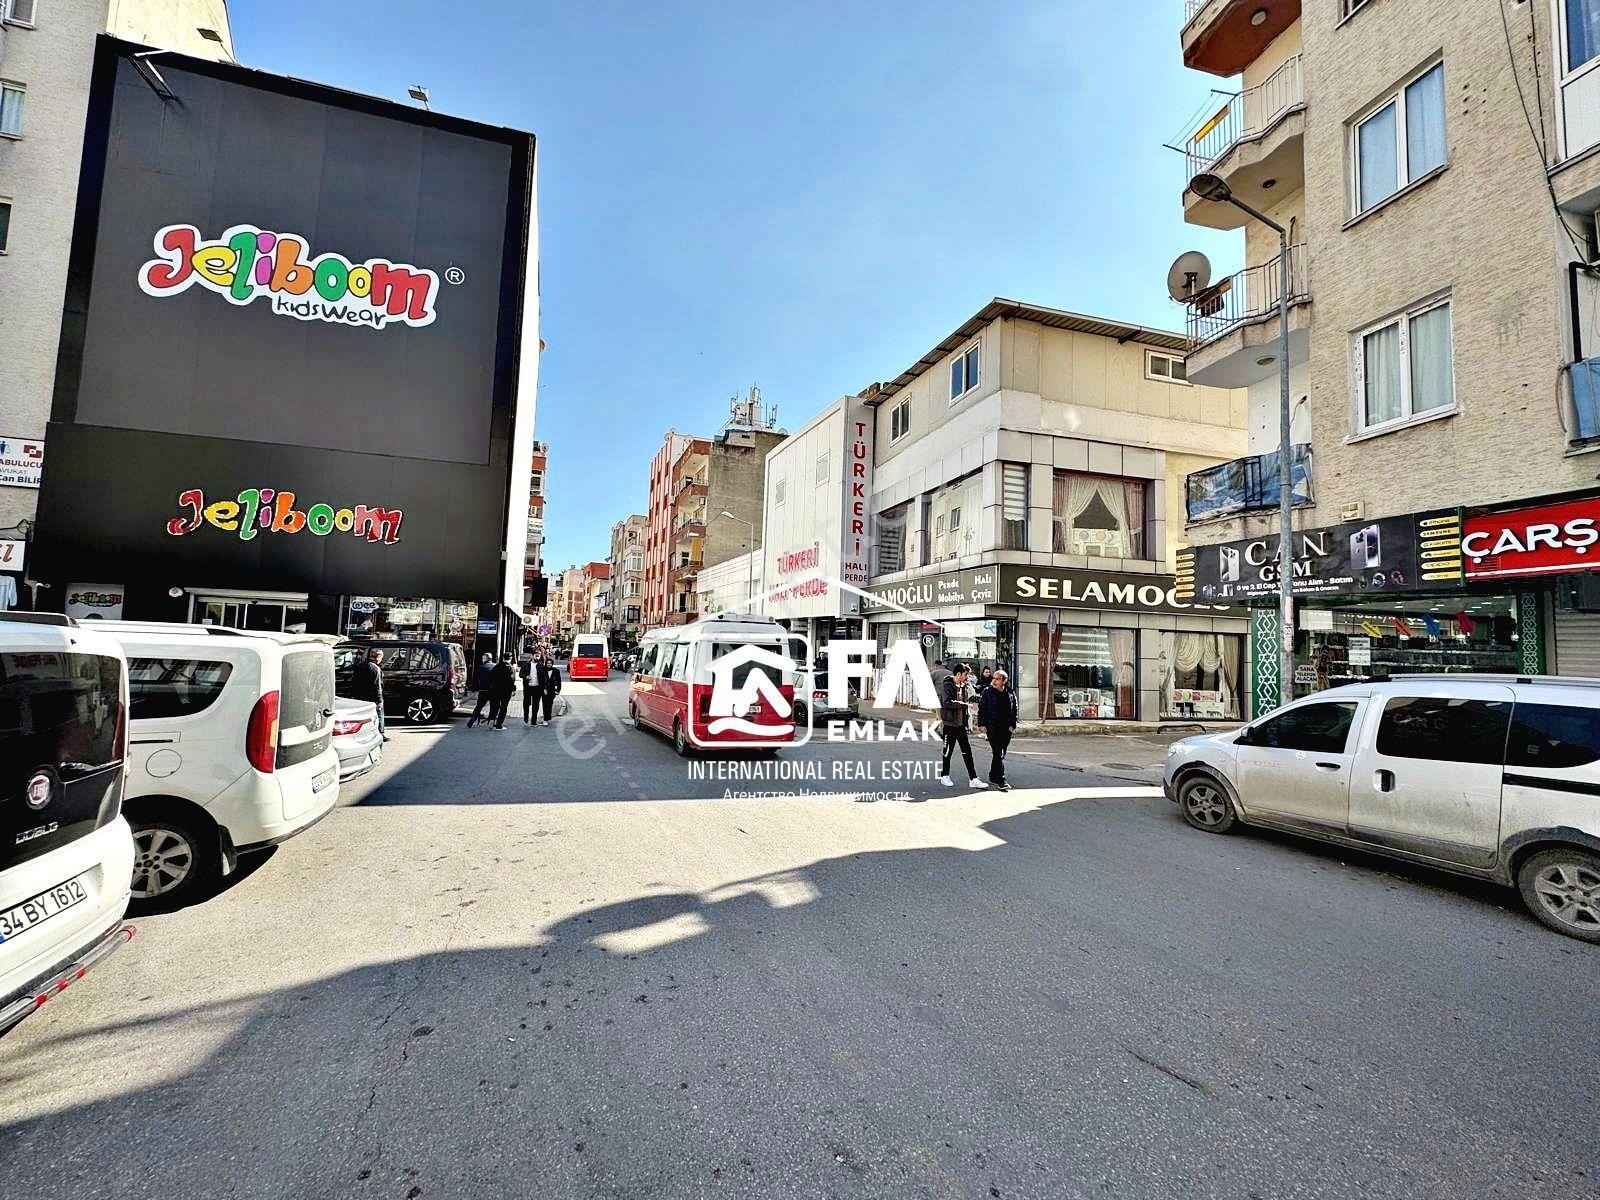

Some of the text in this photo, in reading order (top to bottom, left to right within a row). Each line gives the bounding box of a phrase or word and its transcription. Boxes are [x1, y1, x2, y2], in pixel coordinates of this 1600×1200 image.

[147, 227, 432, 320] Jeliboom
[851, 422, 867, 557] TÜRKERİ
[166, 488, 403, 545] Jeliboom
[1462, 518, 1599, 564] ÇARŞ
[844, 562, 868, 572] HALI
[844, 573, 869, 583] PERDE
[861, 582, 934, 609] SELAMOĞLU
[1015, 575, 1231, 610] SELAMO
[0, 881, 84, 936] 34 BY 1612
